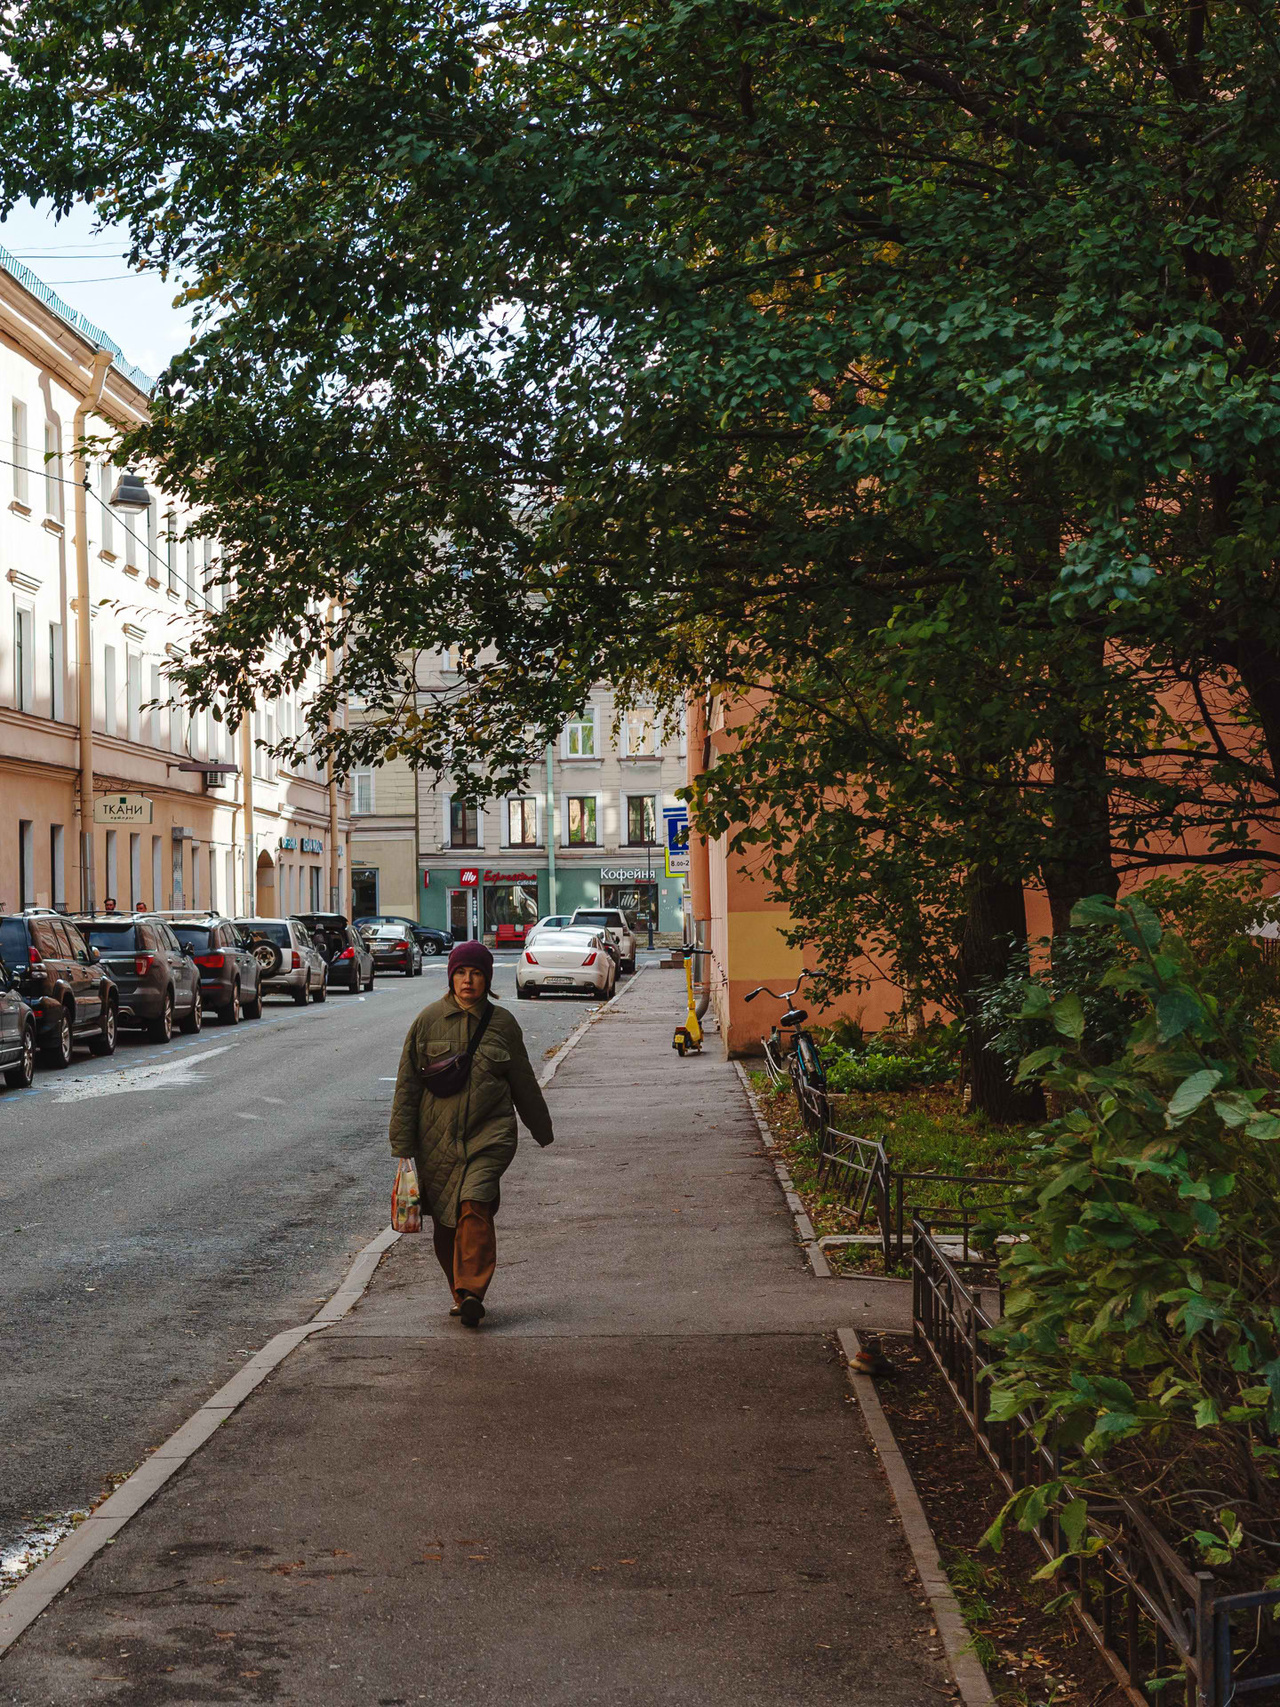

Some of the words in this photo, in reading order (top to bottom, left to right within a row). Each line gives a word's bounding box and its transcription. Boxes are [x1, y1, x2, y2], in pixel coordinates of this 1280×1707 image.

[103, 804, 143, 815] ТКАНИ
[461, 871, 477, 884] illy
[600, 868, 656, 882] Кофейня
[620, 894, 638, 909] illy
